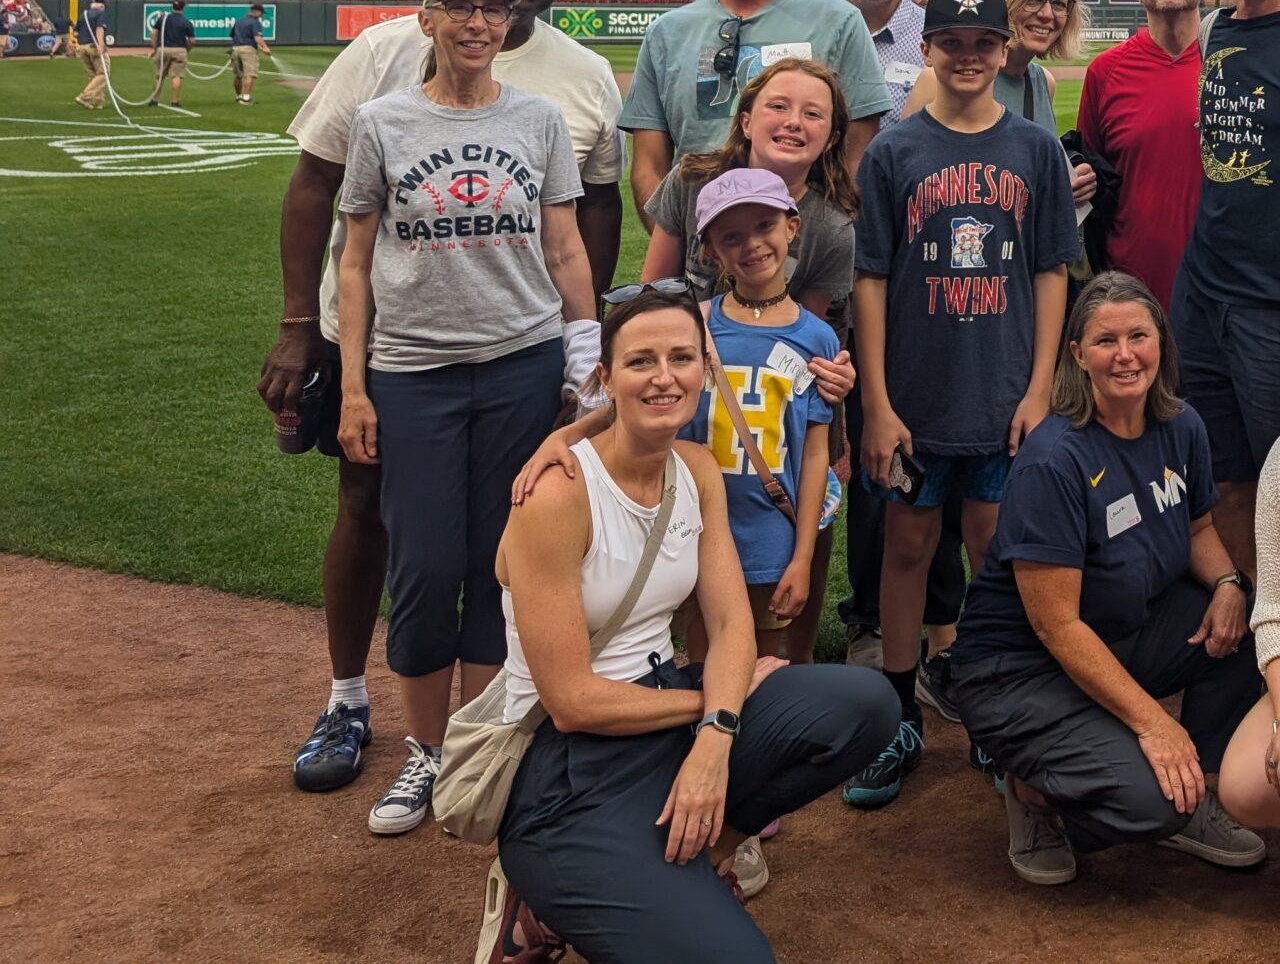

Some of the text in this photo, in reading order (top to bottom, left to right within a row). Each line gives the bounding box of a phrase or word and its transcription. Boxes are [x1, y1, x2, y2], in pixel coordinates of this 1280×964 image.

[608, 26, 647, 35] FINANC
[1111, 30, 1130, 40] FUND
[1215, 68, 1224, 80] A
[1204, 81, 1226, 97] MID
[1214, 96, 1266, 113] SUMMER
[1205, 113, 1253, 129] NIGHT'S
[1219, 130, 1263, 146] DREAM
[395, 144, 540, 206] TWIN CITIES
[922, 242, 938, 261] 19
[1001, 240, 1015, 260] 01
[926, 276, 1009, 315] TWINS
[702, 364, 794, 476] H
